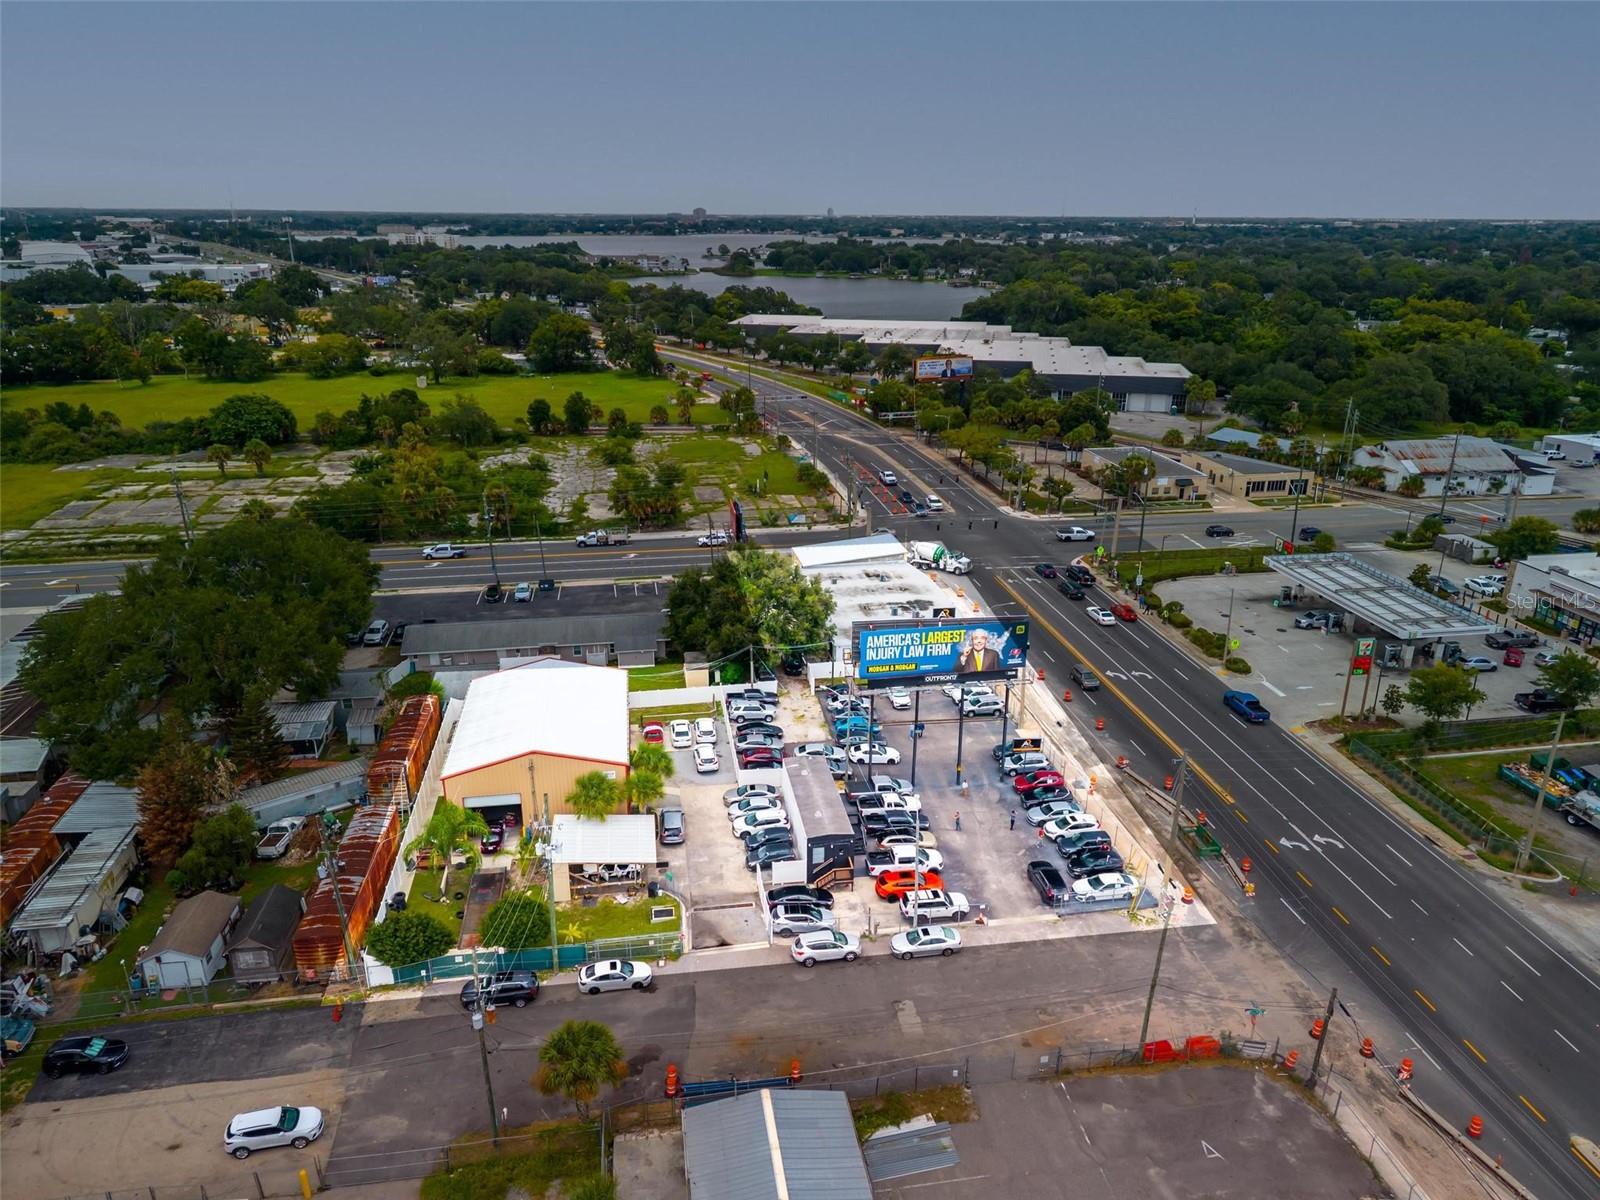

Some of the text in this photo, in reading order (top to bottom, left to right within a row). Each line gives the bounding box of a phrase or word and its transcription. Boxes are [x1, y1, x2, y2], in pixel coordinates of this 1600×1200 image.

[867, 630, 966, 648] AMERICA'S LARGEST
[866, 643, 951, 660] INJURY LAW FIRM
